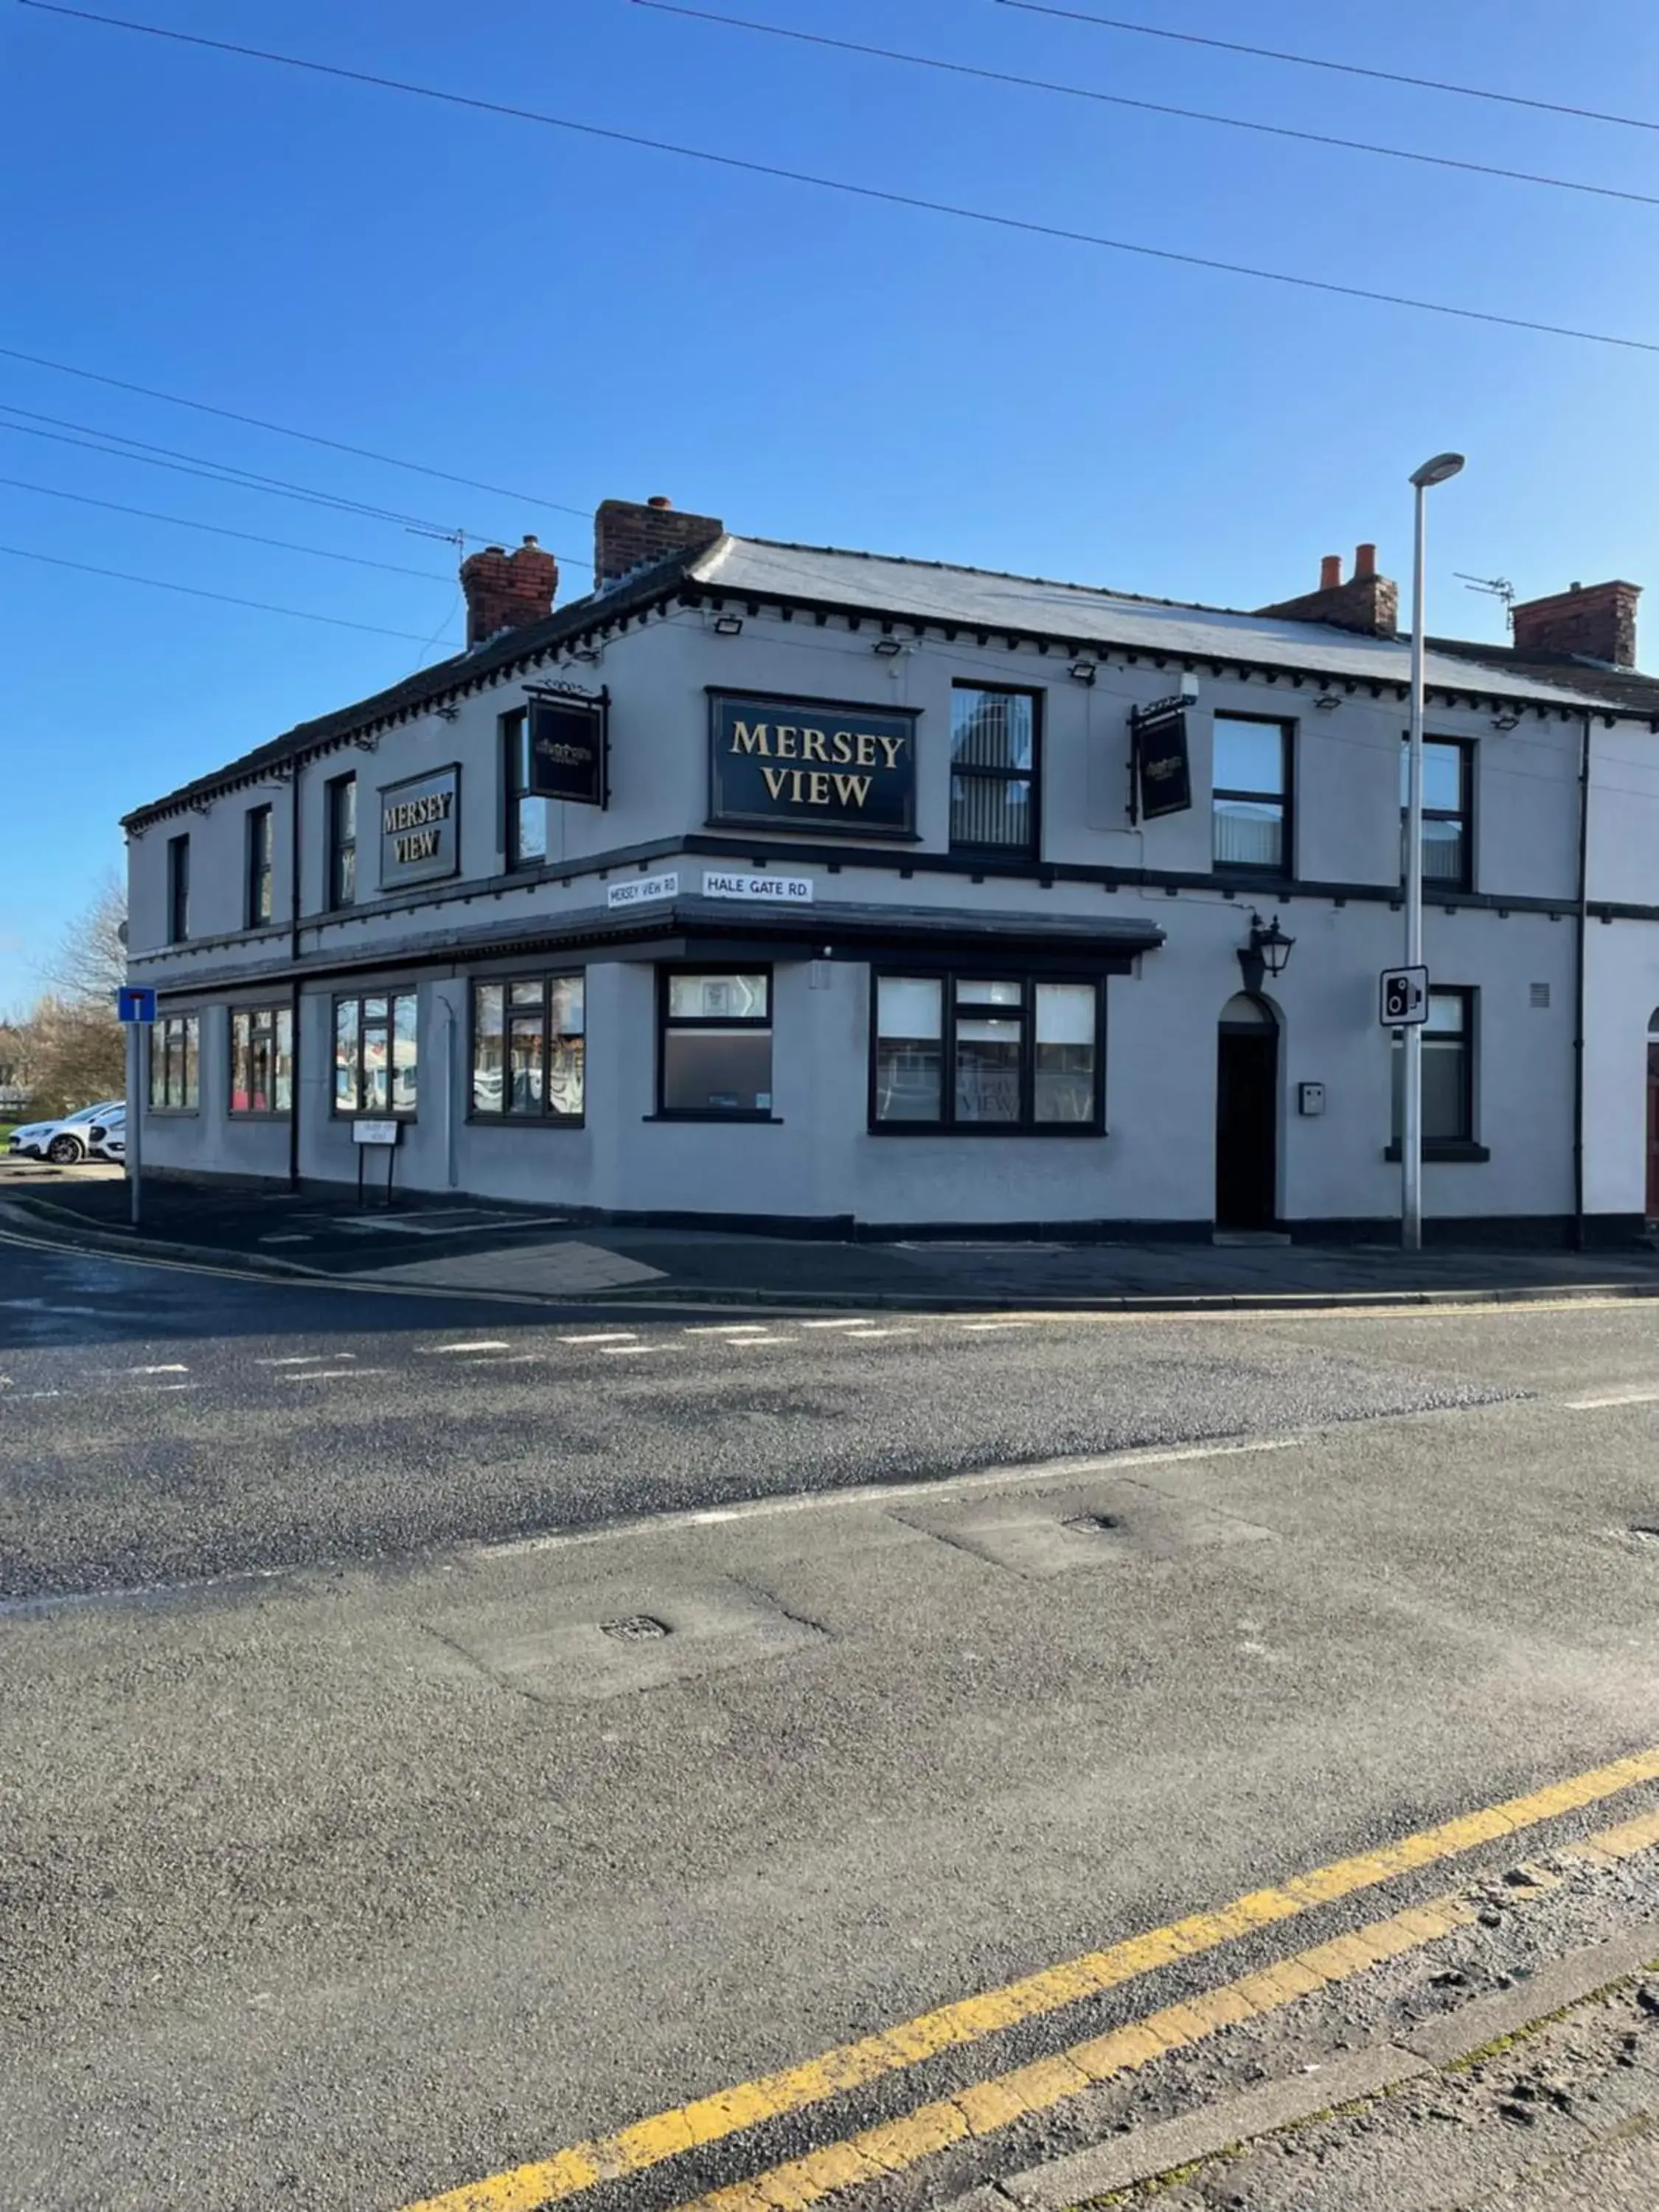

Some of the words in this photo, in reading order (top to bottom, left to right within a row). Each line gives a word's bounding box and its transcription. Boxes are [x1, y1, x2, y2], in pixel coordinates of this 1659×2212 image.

[728, 721, 905, 768] MERSEY
[759, 766, 874, 808] VIEW
[383, 792, 453, 835] MERSEY
[394, 829, 441, 863] VIEW
[611, 886, 639, 901] MERSEY
[641, 882, 661, 896] VIEW
[707, 877, 744, 893] HALE
[749, 880, 783, 895] GATE
